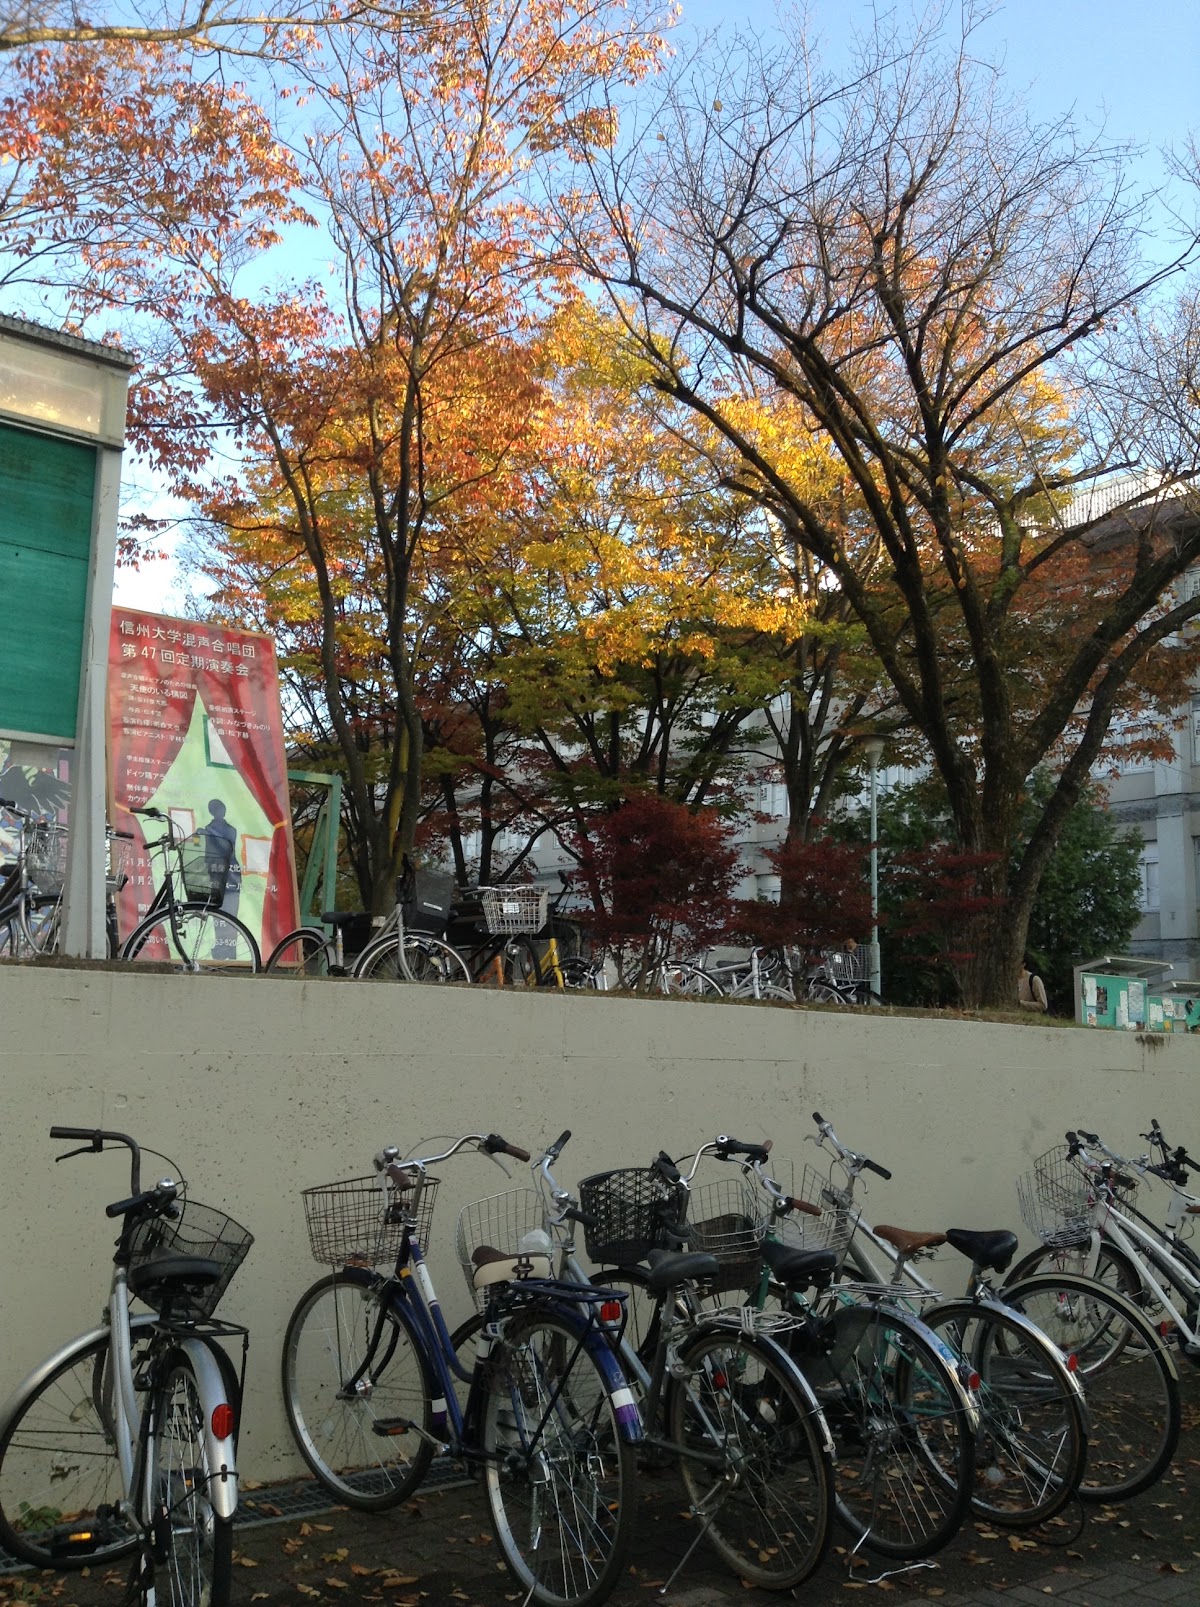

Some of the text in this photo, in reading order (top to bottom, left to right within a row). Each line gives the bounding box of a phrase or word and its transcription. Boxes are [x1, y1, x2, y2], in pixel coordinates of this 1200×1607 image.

[120, 620, 255, 658] 信州大学混声合唱団
[122, 643, 249, 676] 第47回定期演奏会
